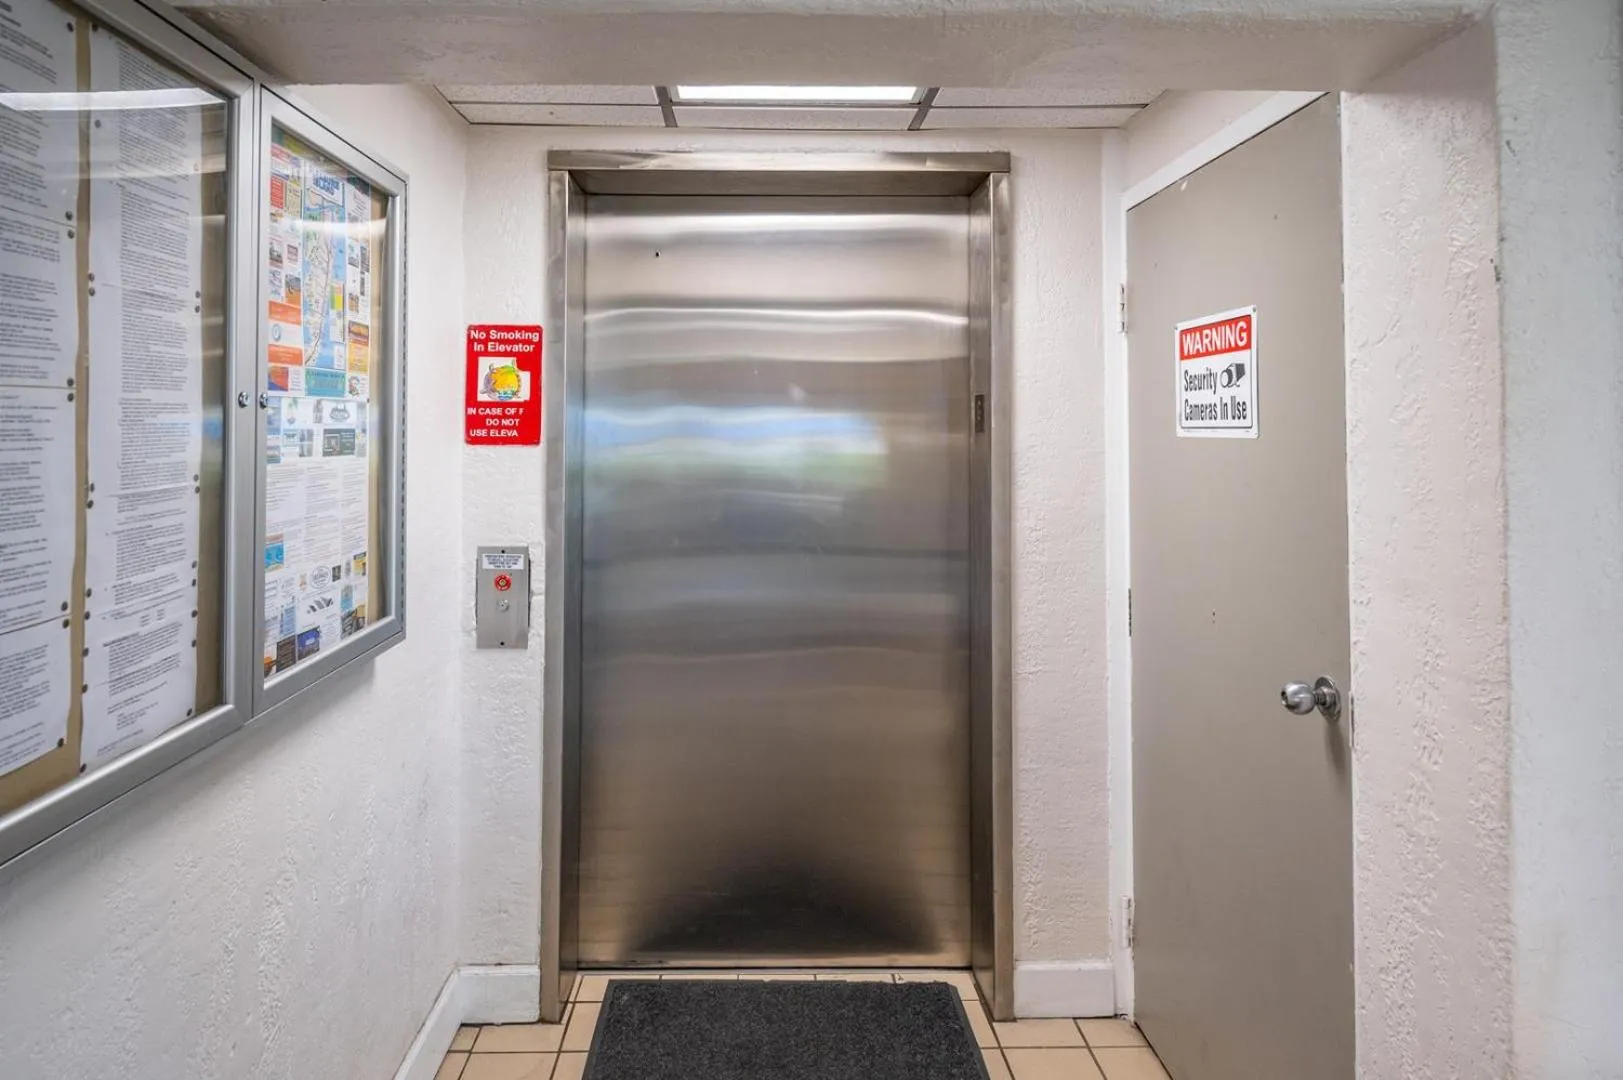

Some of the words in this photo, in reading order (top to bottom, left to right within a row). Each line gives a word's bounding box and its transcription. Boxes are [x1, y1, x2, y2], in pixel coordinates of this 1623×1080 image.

[470, 330, 486, 340] No
[489, 330, 540, 342] Smoking
[1182, 320, 1247, 356] WARNING
[473, 342, 485, 352] In
[488, 342, 535, 352] Elevator
[1184, 366, 1218, 395] Security
[467, 407, 477, 415] IN
[478, 407, 503, 415] CASE
[504, 407, 518, 415] OF
[1184, 398, 1218, 421] Cameras
[1219, 396, 1229, 420] In
[1230, 395, 1247, 421] Use
[485, 418, 500, 426] DO
[501, 418, 520, 426] NOT
[470, 428, 488, 437] USE
